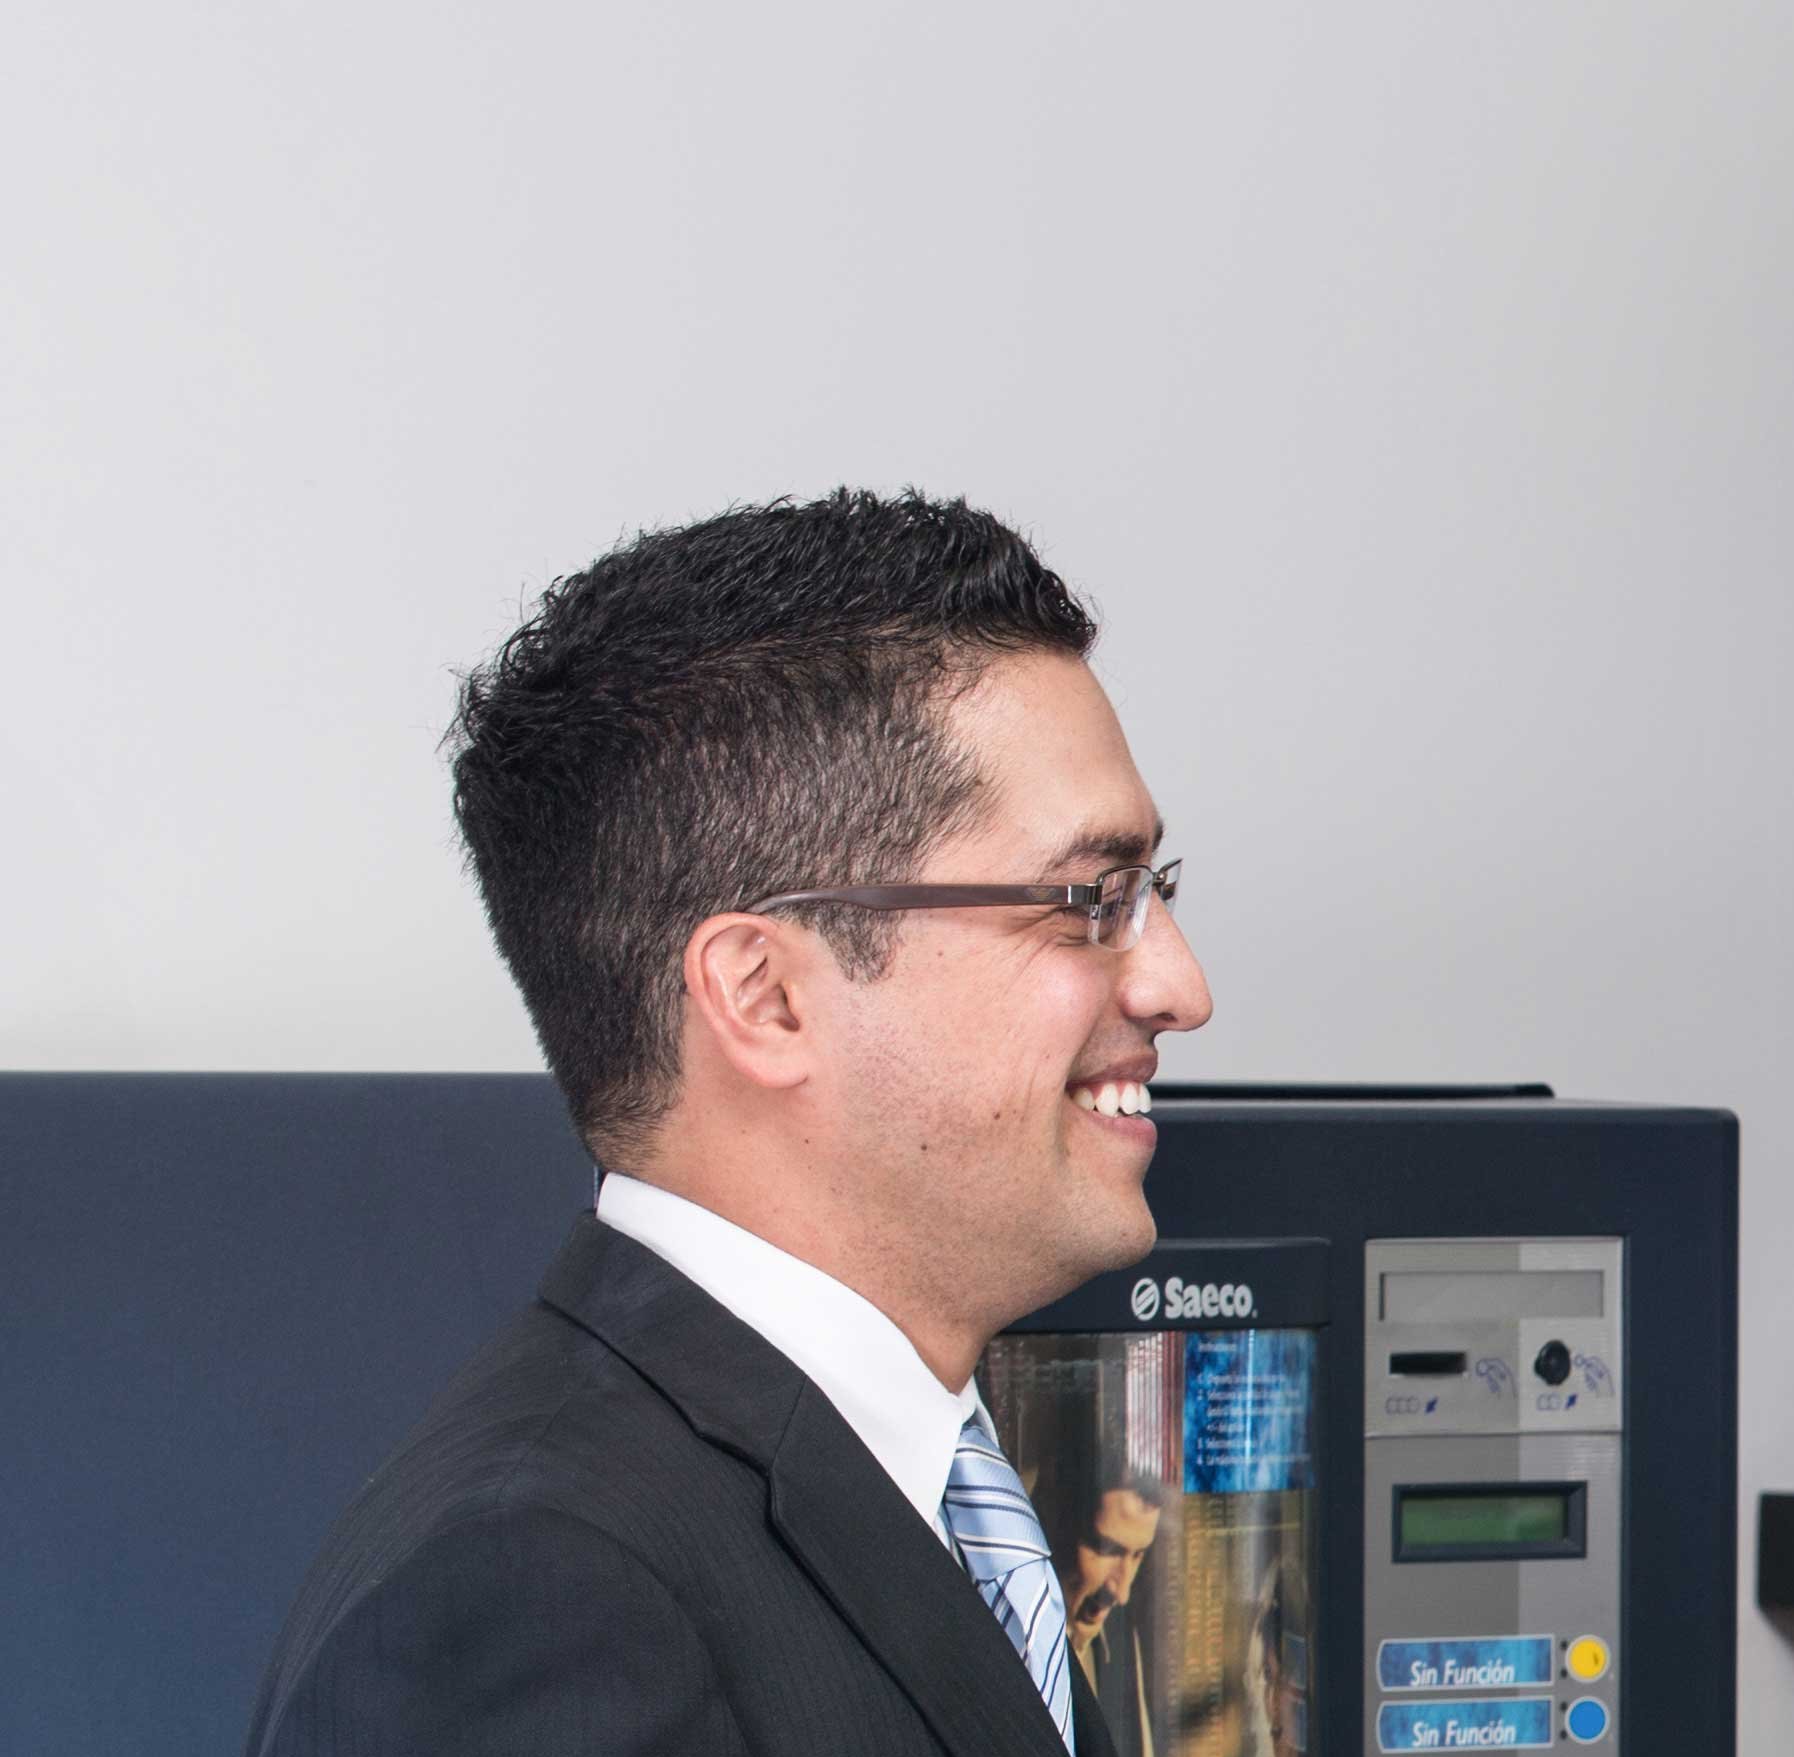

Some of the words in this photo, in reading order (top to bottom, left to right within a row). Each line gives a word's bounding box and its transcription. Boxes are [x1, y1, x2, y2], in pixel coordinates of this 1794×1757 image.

[1165, 1276, 1254, 1319] Saeco
[1410, 1660, 1437, 1687] Sin
[1442, 1659, 1516, 1686] Función
[1412, 1721, 1439, 1747] Sin
[1444, 1719, 1517, 1745] Función
